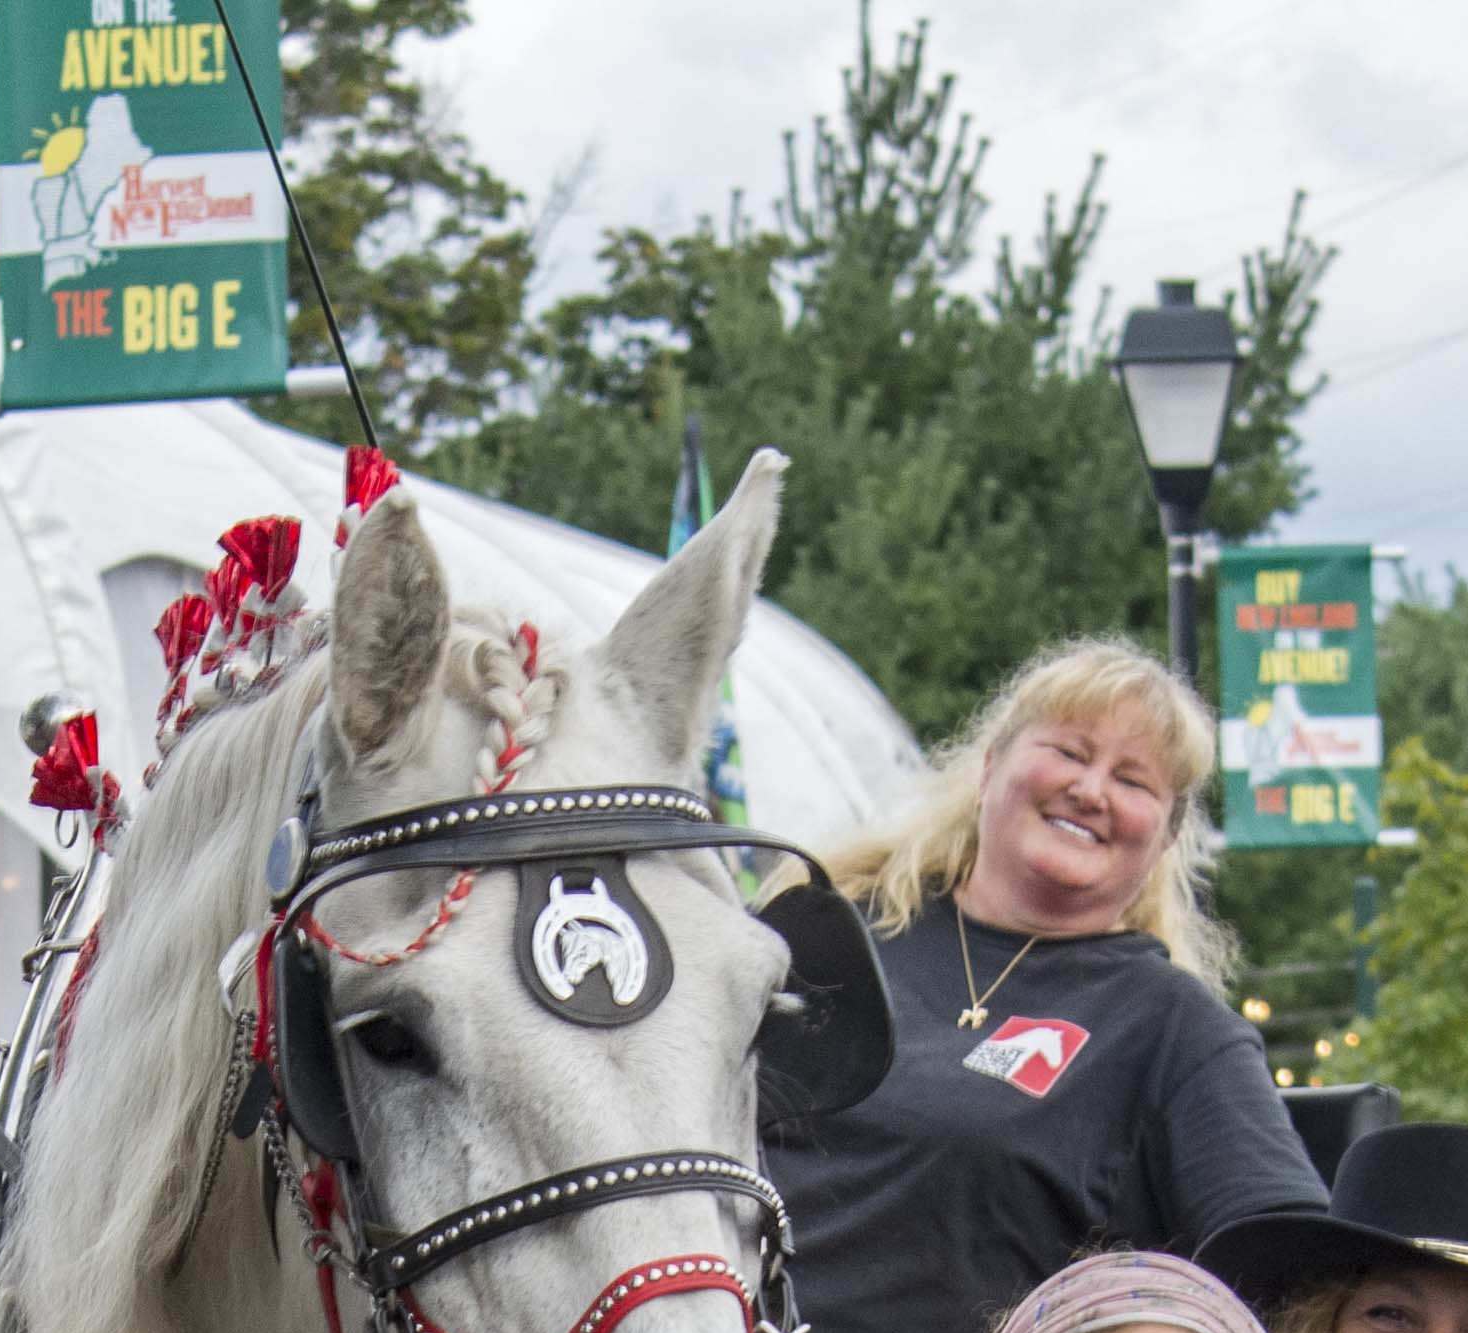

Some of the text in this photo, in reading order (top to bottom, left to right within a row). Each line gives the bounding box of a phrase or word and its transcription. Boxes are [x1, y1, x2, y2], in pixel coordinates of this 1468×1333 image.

[60, 23, 226, 91] AVENUE!
[52, 280, 242, 354] THE BIG E
